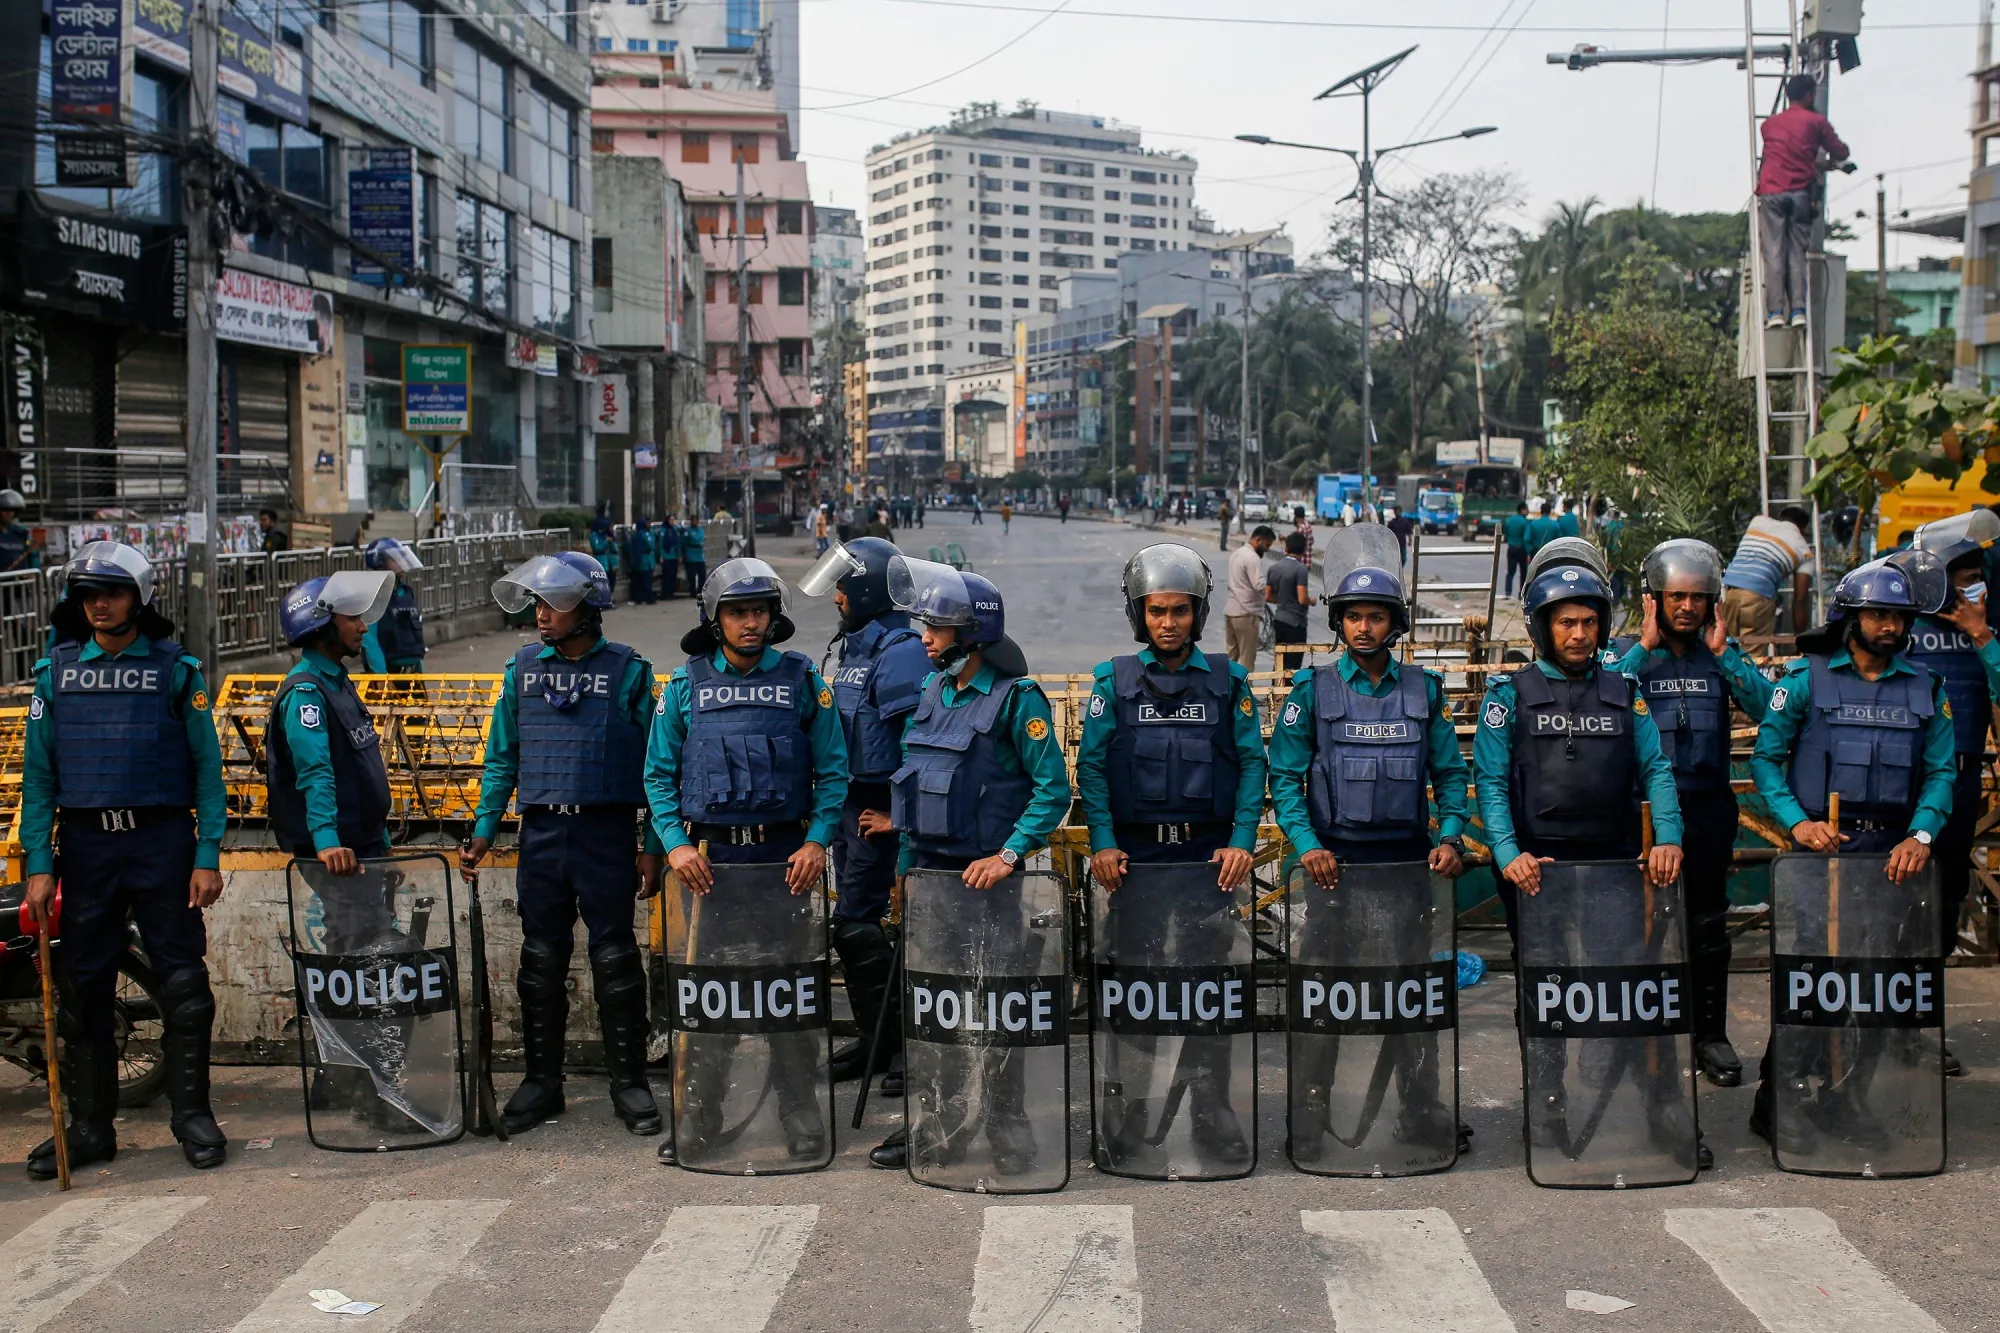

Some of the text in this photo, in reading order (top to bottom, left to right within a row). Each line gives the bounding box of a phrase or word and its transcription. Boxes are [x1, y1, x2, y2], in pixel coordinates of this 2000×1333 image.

[55, 2, 118, 28] লাইফ
[55, 31, 118, 56] ডেন্টাল
[64, 59, 110, 80] হোম
[58, 216, 141, 260] SAMSUNG
[173, 238, 187, 318] SAMSUNG
[598, 383, 619, 426] Apex
[409, 413, 463, 425] minister
[288, 596, 313, 614] POLICE
[976, 602, 999, 611] POLICE
[1909, 632, 1976, 651] POLIC
[60, 669, 159, 690] POLICE
[1660, 680, 1700, 691] POLICE
[699, 685, 790, 707] POLICE
[1145, 707, 1199, 718] PICE
[1843, 707, 1899, 720] POLICE
[1355, 725, 1398, 737] POLICE
[305, 962, 444, 1007] POLICE
[1789, 971, 1933, 1013] POLICE
[677, 976, 818, 1019] POLICE
[913, 986, 1052, 1031] POLICE
[1102, 979, 1242, 1020] POLICE
[1302, 976, 1445, 1020] POLICE
[1537, 978, 1681, 1023] POLICE
